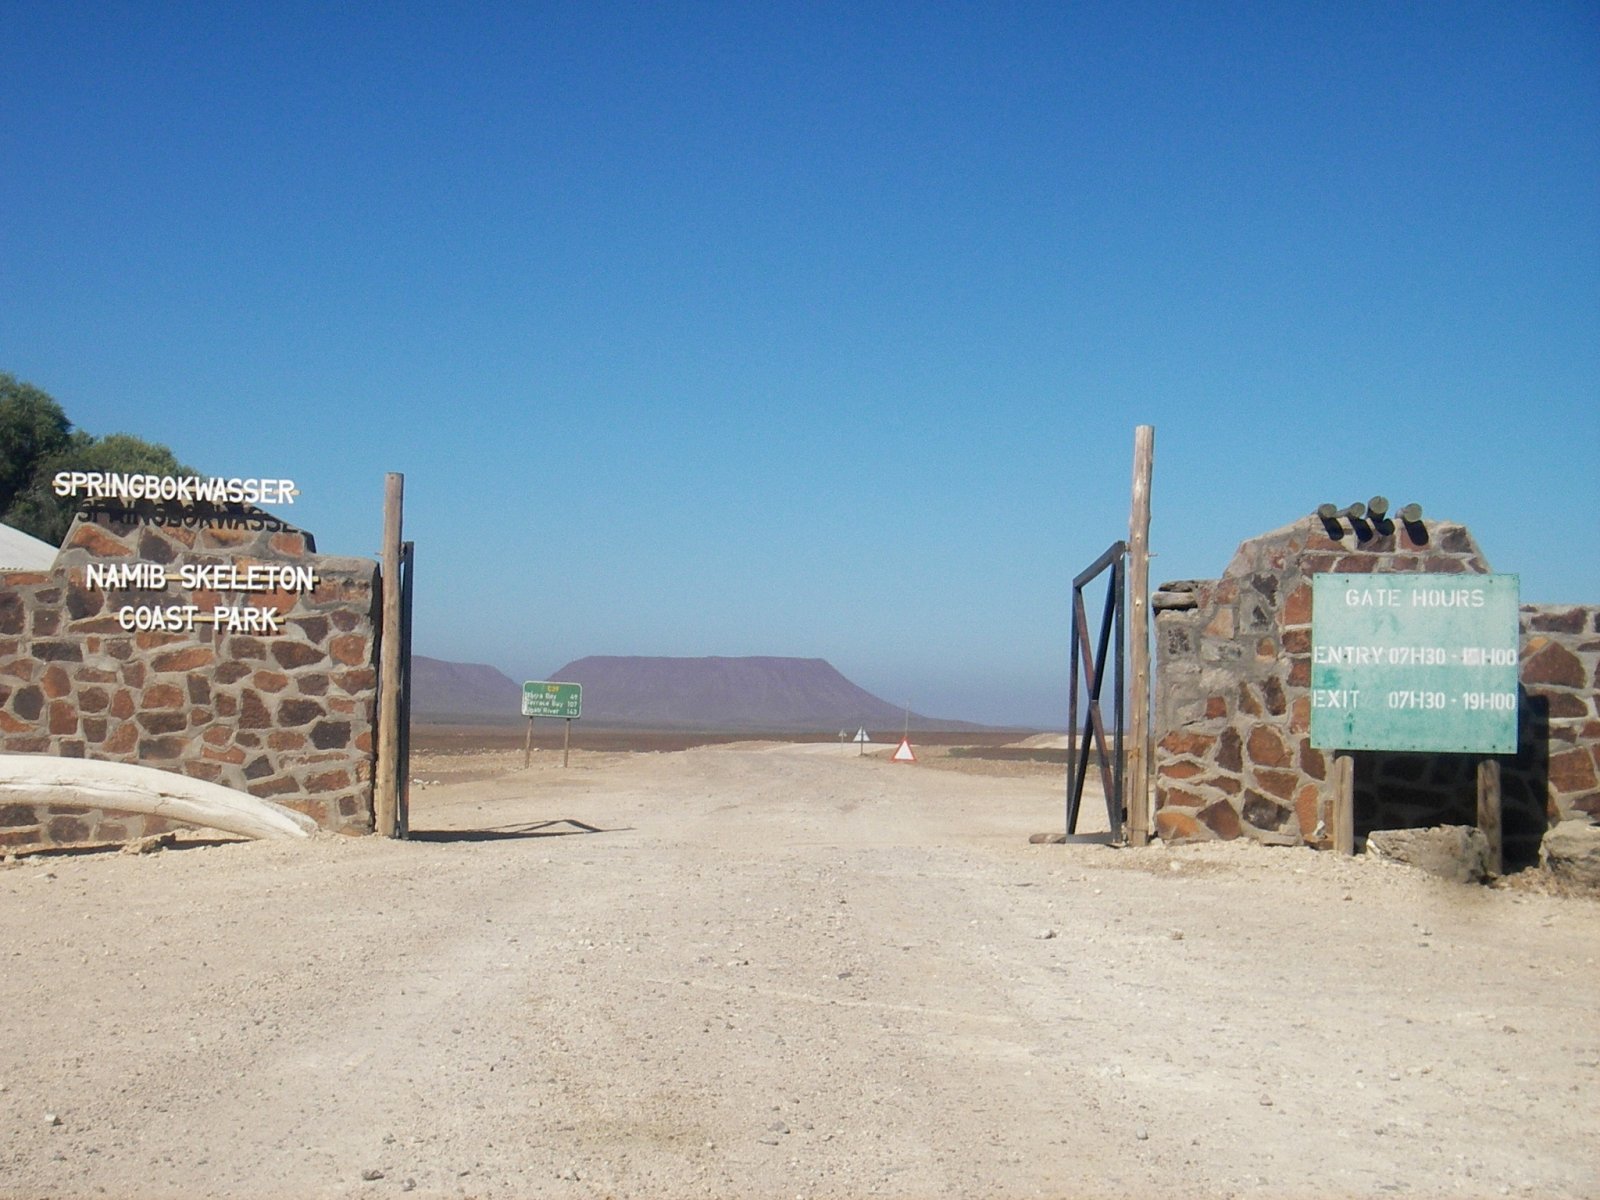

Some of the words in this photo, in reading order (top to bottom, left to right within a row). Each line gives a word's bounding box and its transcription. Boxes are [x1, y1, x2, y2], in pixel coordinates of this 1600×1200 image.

[55, 472, 294, 504] SPRINGBOKWASSER
[86, 564, 166, 590] NAMIB
[180, 565, 314, 591] SKELETON
[1345, 589, 1402, 607] GATE
[1412, 589, 1485, 608] HOURS
[118, 605, 198, 631] COAST
[214, 606, 279, 631] PARK
[1313, 646, 1383, 664] ENTRY
[1388, 647, 1446, 665] 07H30
[1313, 690, 1360, 708] EXIT
[1388, 691, 1446, 709] 07H30
[1462, 692, 1516, 710] 19H00
